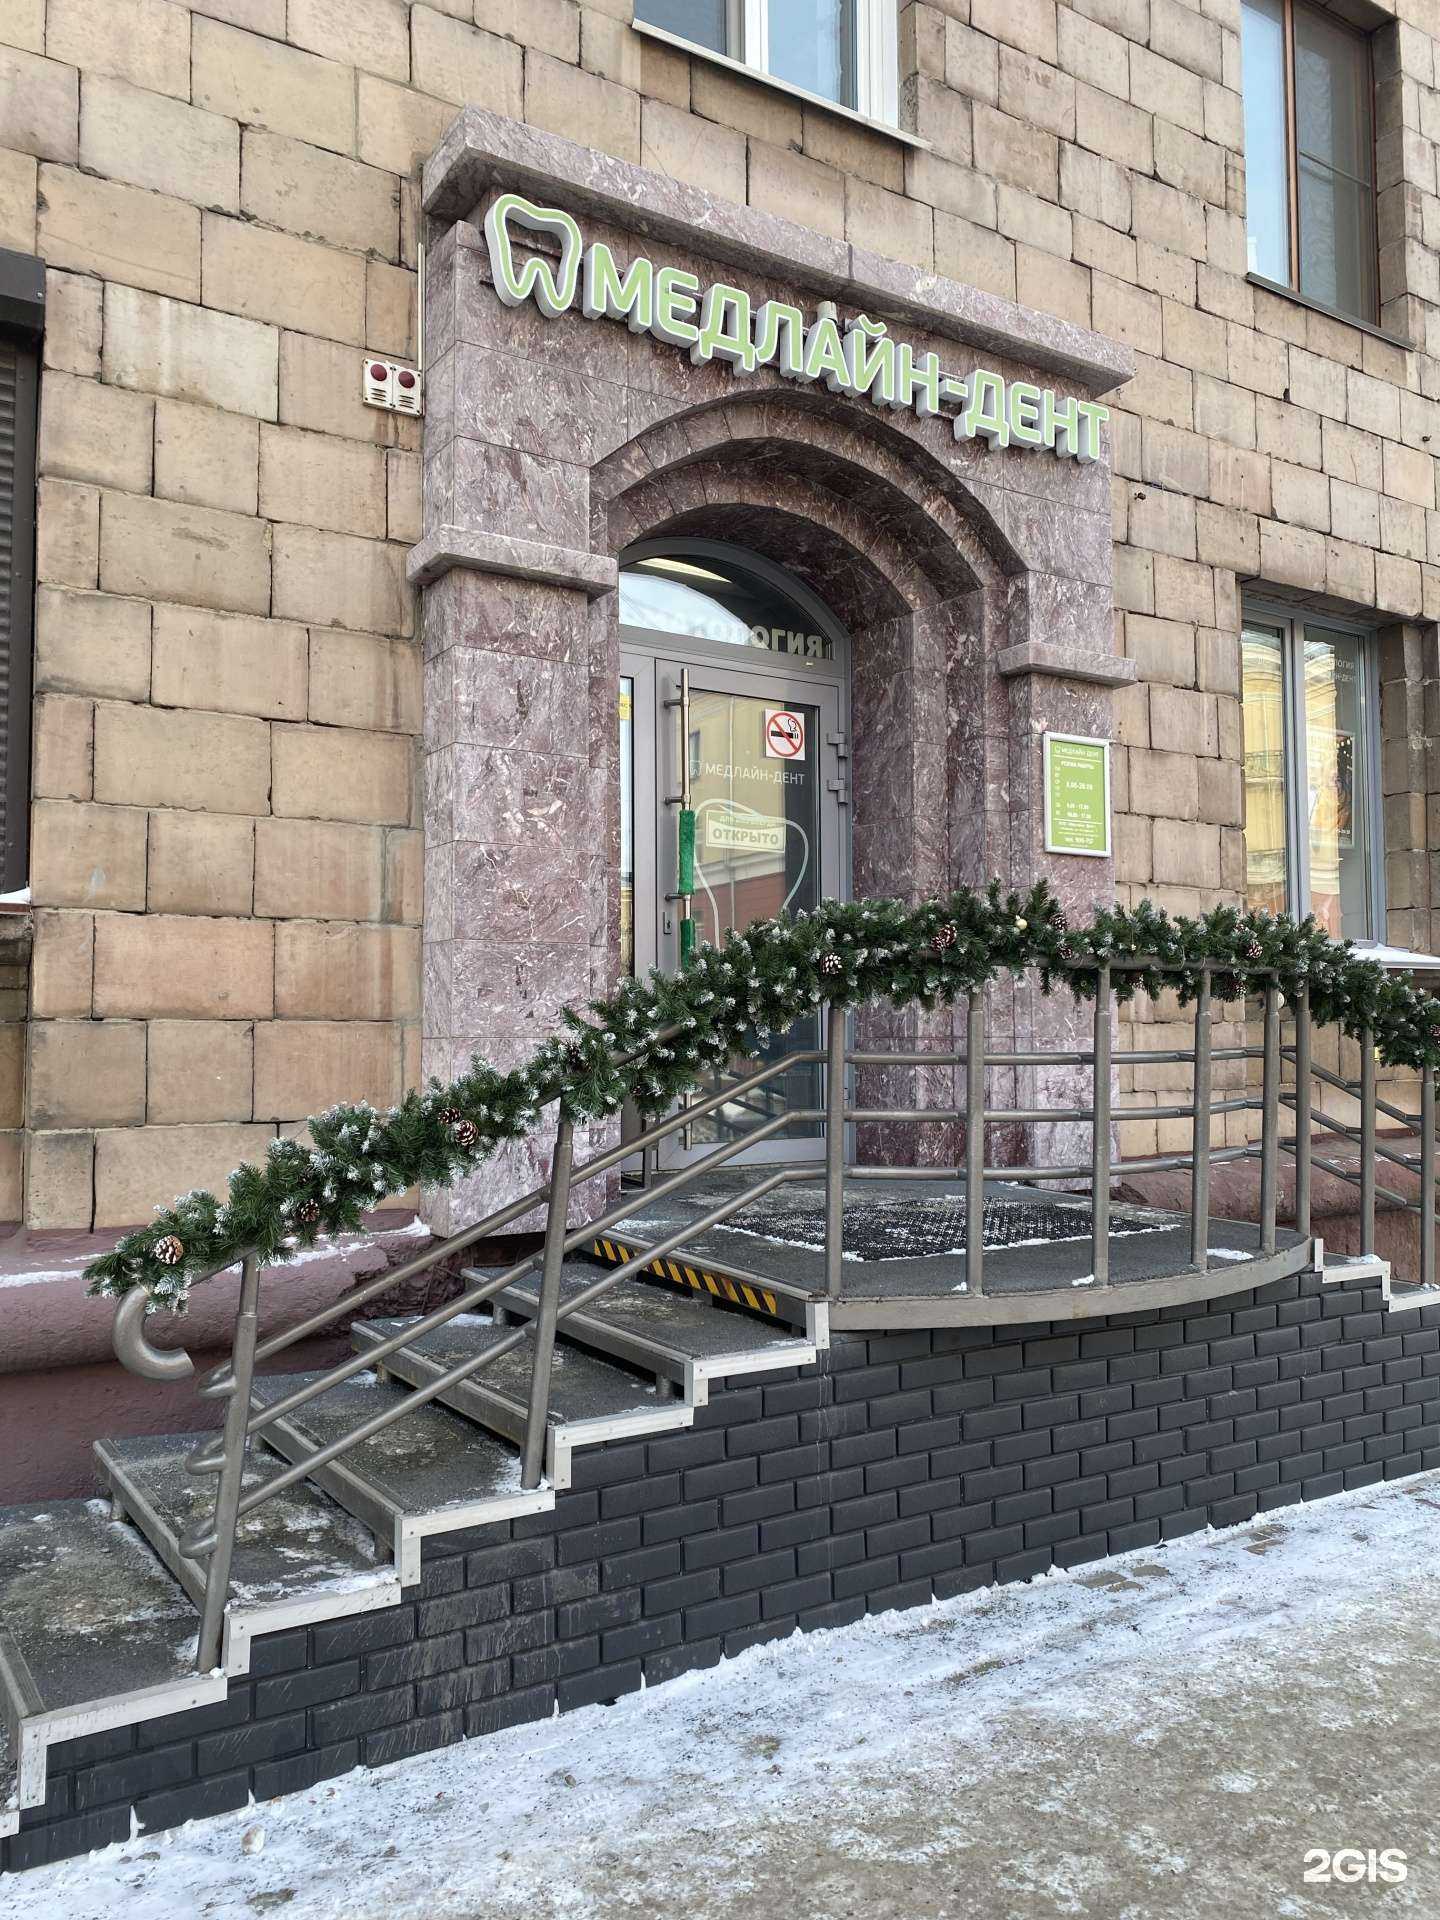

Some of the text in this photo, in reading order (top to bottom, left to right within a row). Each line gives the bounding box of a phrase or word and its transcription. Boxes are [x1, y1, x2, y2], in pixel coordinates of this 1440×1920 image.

[584, 243, 1108, 463] МЕДЛАЙН-ДЕНТ
[705, 762, 805, 785] МЕДЛАЙН-ДЕНТ
[712, 828, 779, 845] ОТКРЫТО
